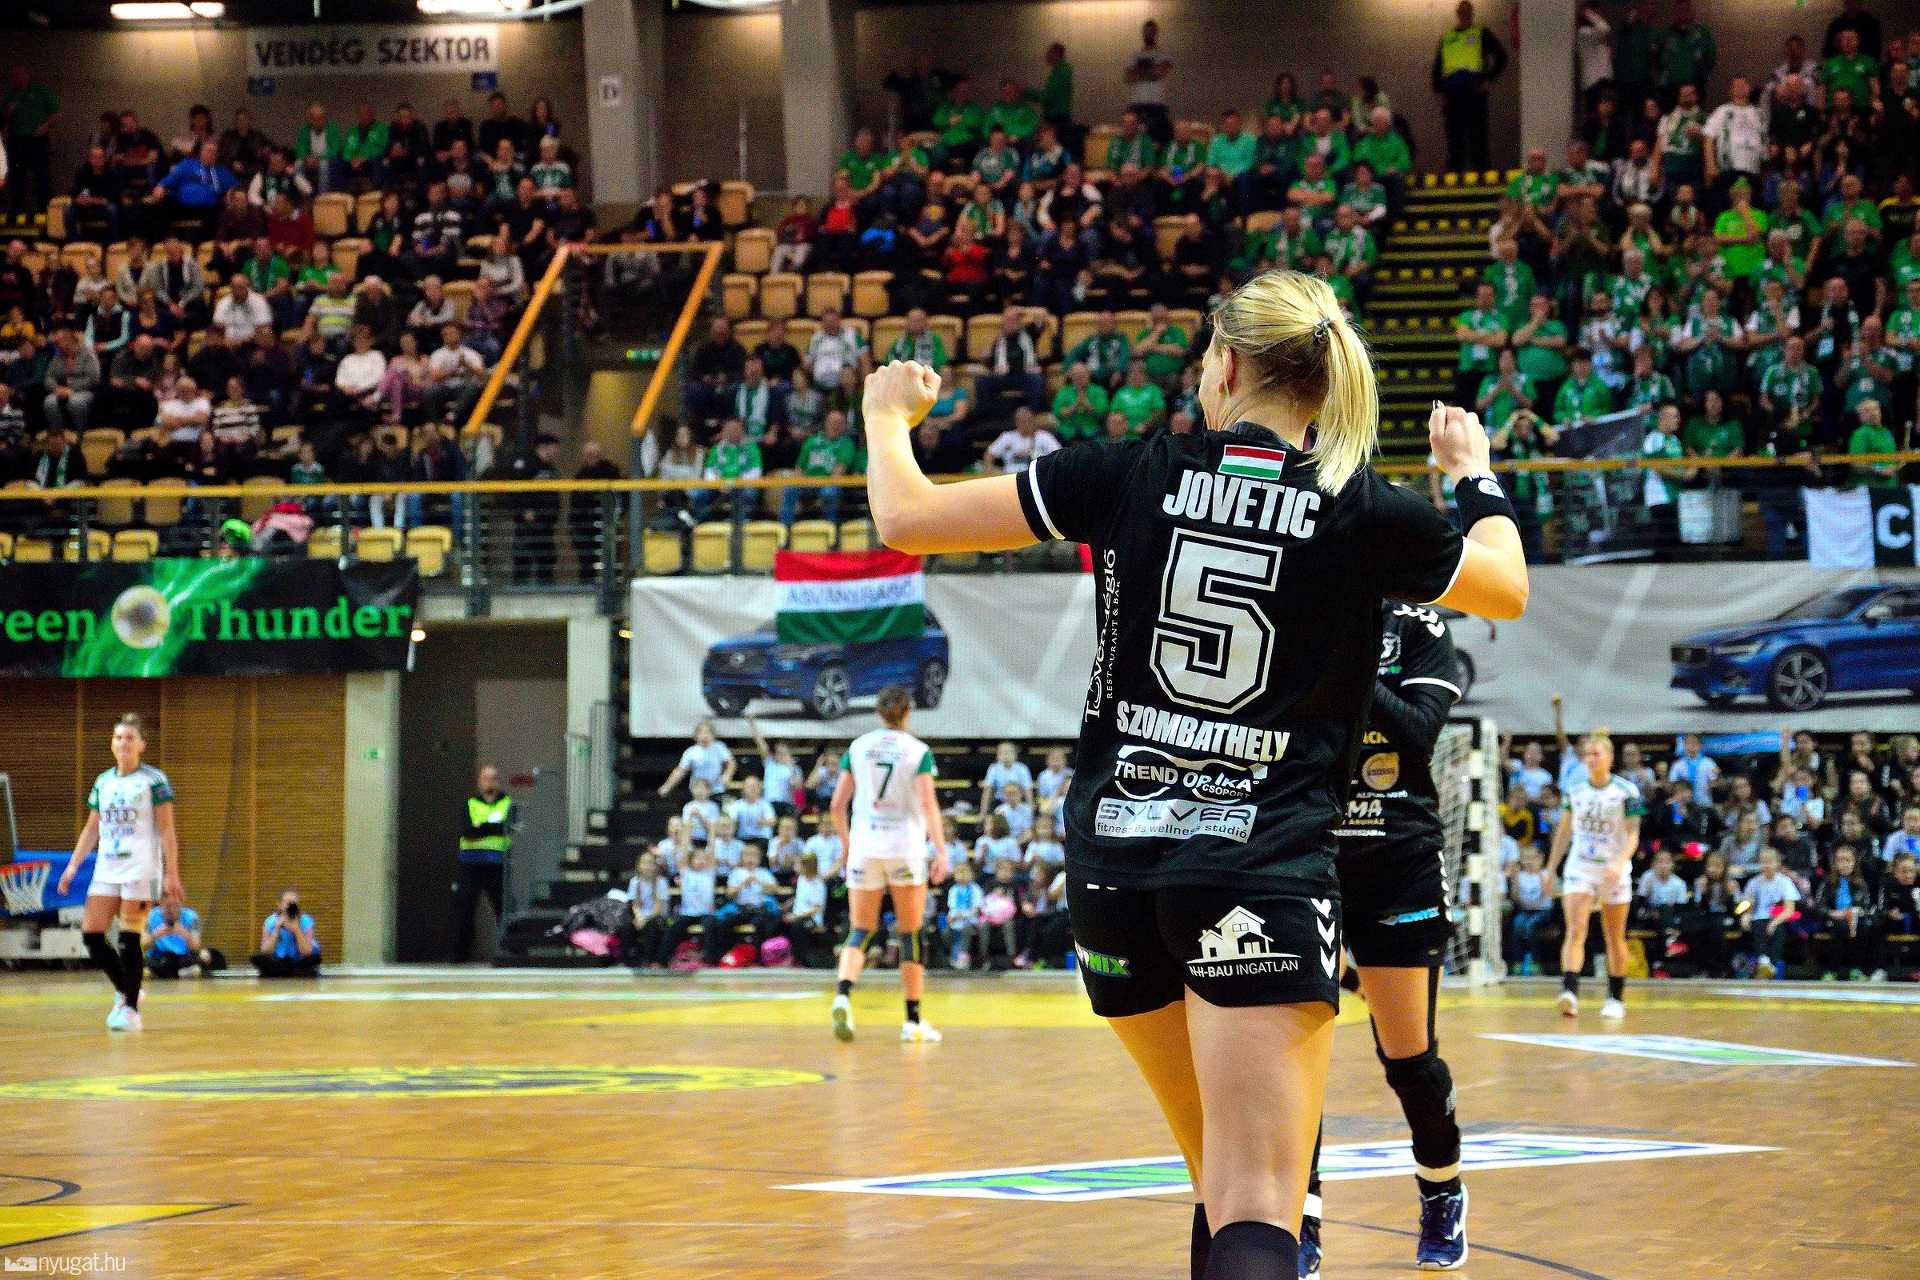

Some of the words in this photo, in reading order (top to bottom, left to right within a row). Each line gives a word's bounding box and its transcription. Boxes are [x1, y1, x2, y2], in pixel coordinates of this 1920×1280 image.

[255, 37, 365, 67] VENDÉG
[378, 37, 491, 65] SZEKTOR
[1162, 470, 1321, 539] JOVETIC
[0, 608, 95, 642] een
[186, 597, 413, 642] Thunder
[1150, 527, 1283, 714] 5
[1106, 620, 1119, 699] RESTAURANT
[1117, 700, 1291, 762] SZOMBATHELY
[875, 762, 894, 800] 7
[1114, 760, 1179, 785] TREND
[1202, 784, 1251, 800] CSOPORT
[1097, 822, 1133, 834] fitnes
[1098, 803, 1251, 825] SYLVER
[1188, 964, 1233, 978] NH-BAU
[1235, 959, 1299, 976] INGATLAN
